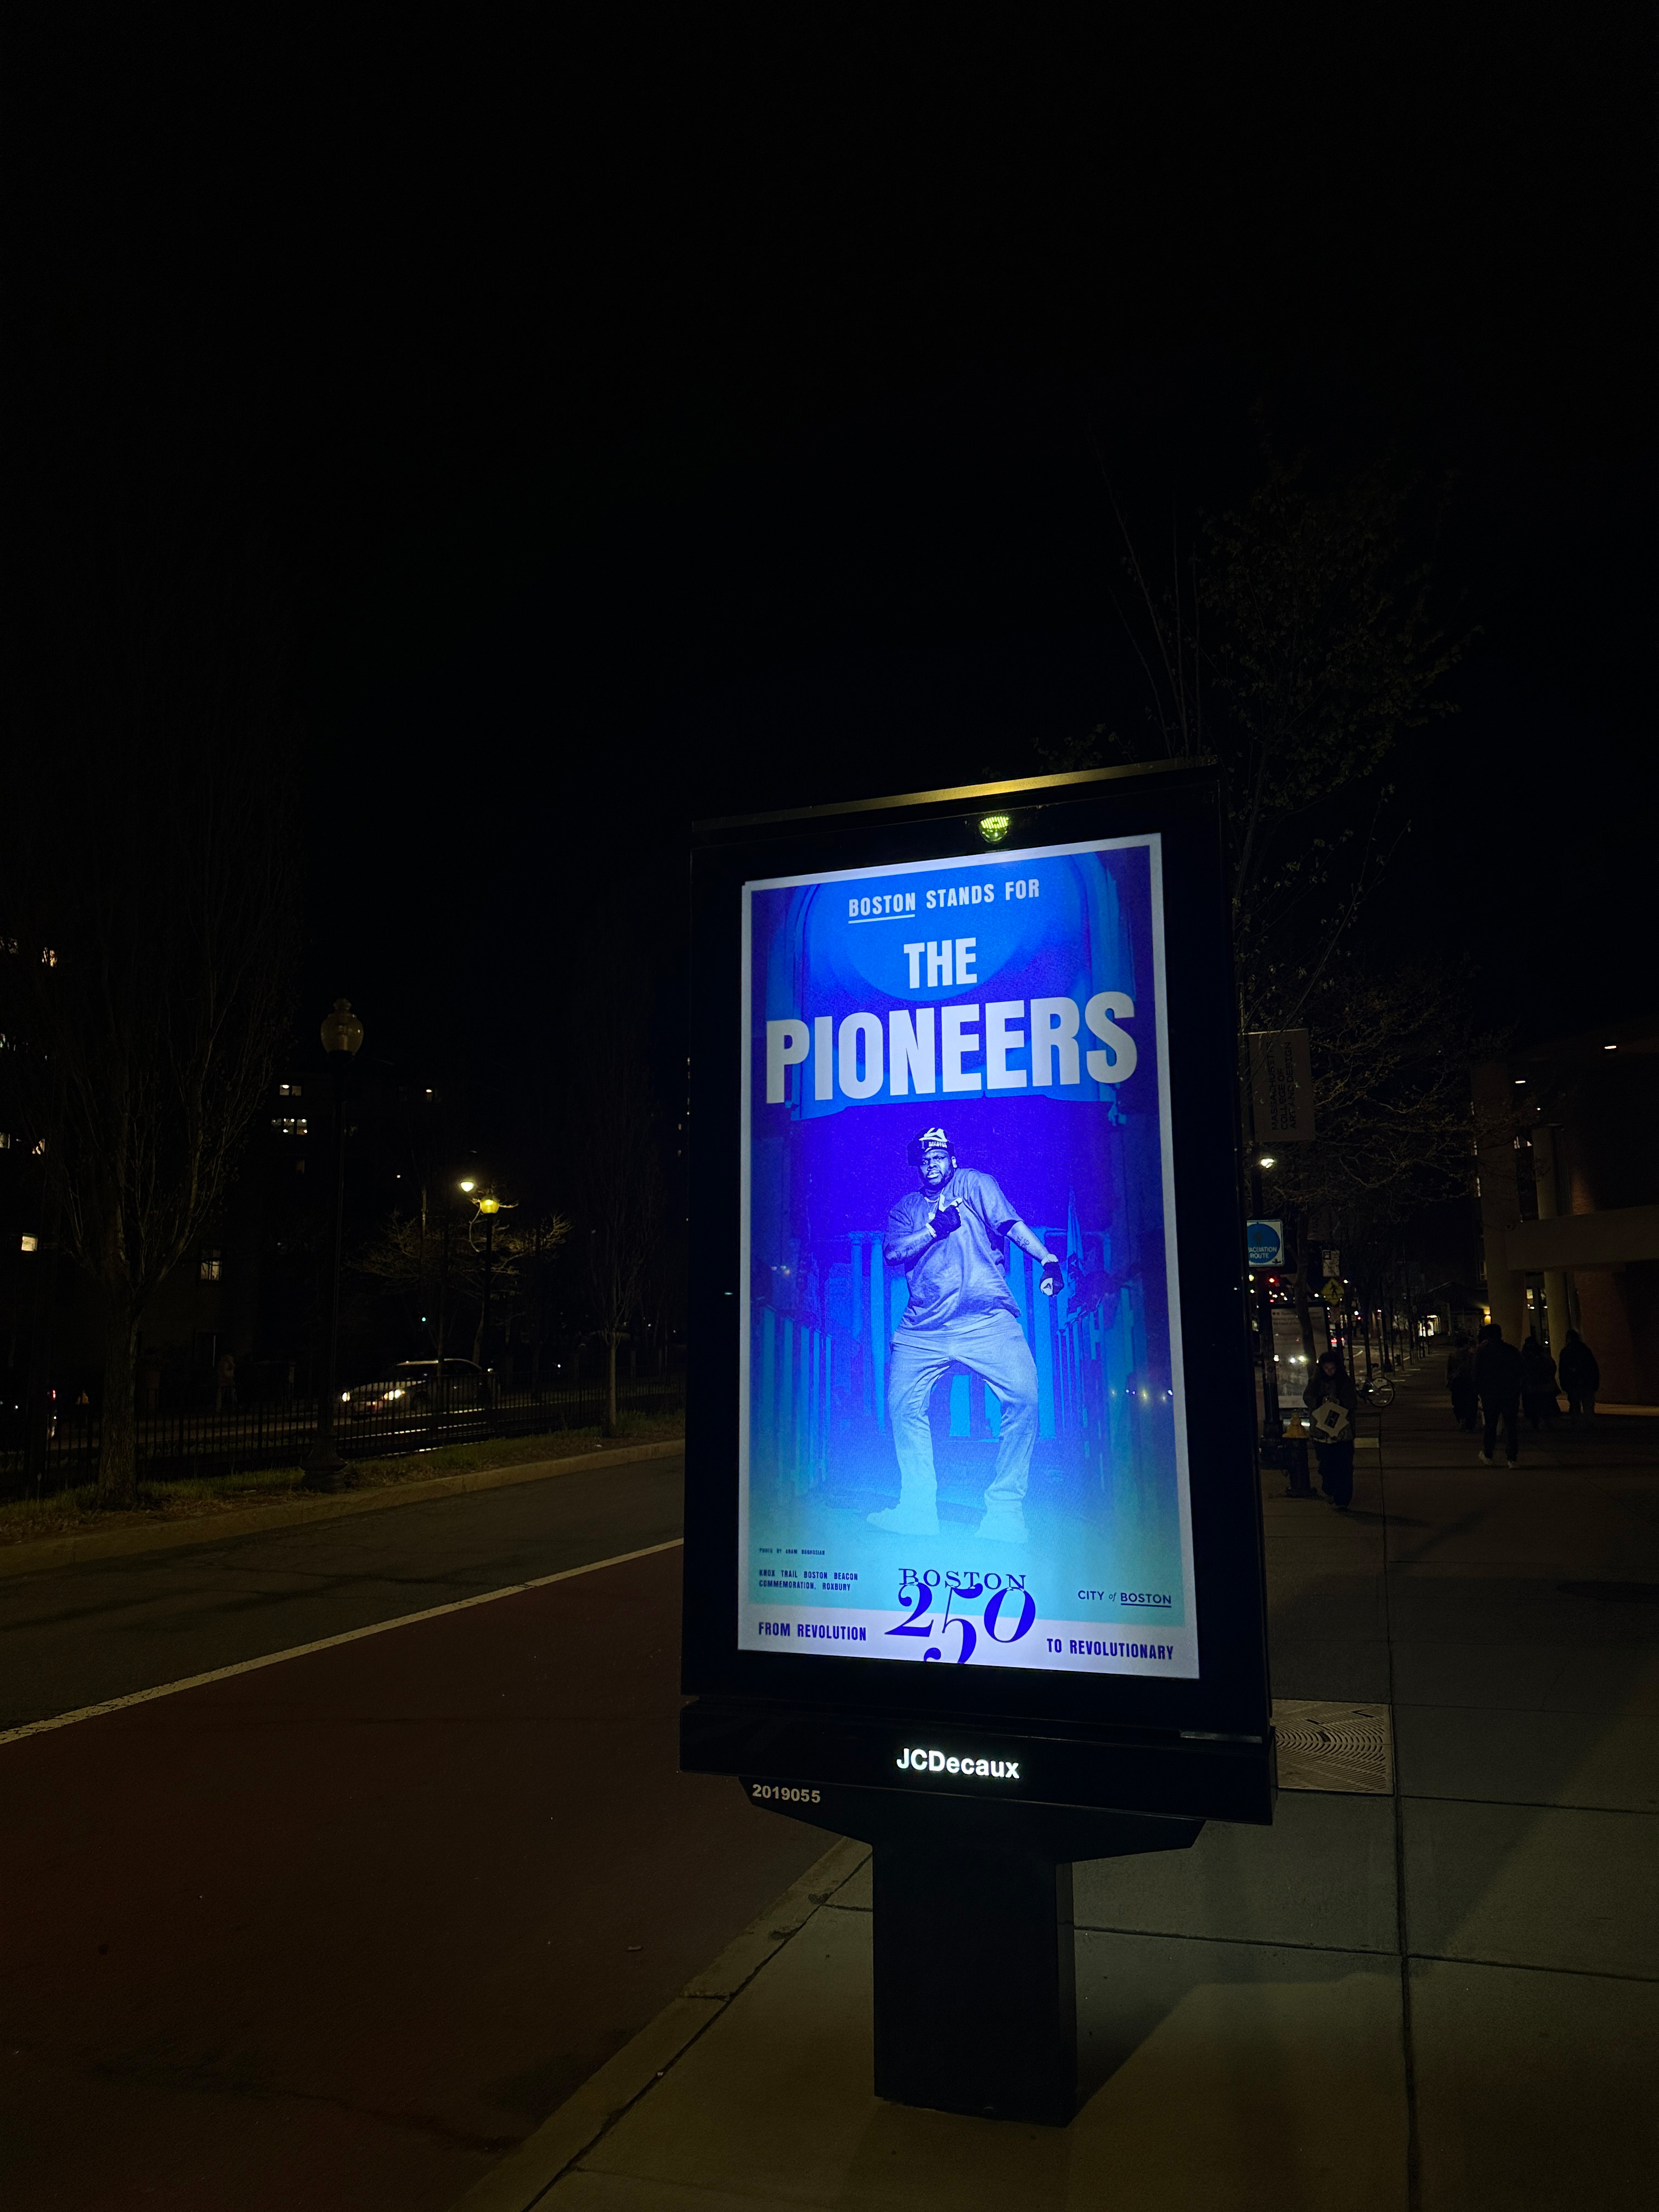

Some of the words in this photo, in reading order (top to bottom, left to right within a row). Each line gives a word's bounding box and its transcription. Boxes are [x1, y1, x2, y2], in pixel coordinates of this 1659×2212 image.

[849, 892, 916, 917] BOSTON
[926, 883, 995, 909] STANDS
[1005, 878, 1040, 901] FOR
[903, 936, 978, 989] THE
[766, 991, 1138, 1104] PIONEERS
[1285, 1042, 1294, 1082] DESIGN
[1278, 1068, 1285, 1082] OF
[1278, 1085, 1288, 1130] COLLEGE
[1289, 1109, 1297, 1129] ART
[759, 1569, 775, 1577] KNOX
[781, 1570, 798, 1578] TRAIL
[804, 1571, 828, 1579] BOSTON
[834, 1572, 858, 1581] BEACON
[759, 1579, 816, 1590] COMMEMORATION,
[822, 1582, 851, 1592] ROXBURY
[898, 1568, 1026, 1590] BOSTON
[1077, 1590, 1104, 1601] CITY
[1108, 1592, 1117, 1602] of
[1120, 1593, 1172, 1605] BOSTON
[758, 1622, 791, 1637] FROM
[797, 1623, 867, 1641] REVOLUTION
[884, 1582, 1036, 1664] 250
[1047, 1638, 1062, 1654] TO
[1069, 1639, 1173, 1660] REVOLUTIONARY
[896, 1747, 1020, 1780] JCDecaux
[752, 1784, 821, 1804] 2019055
